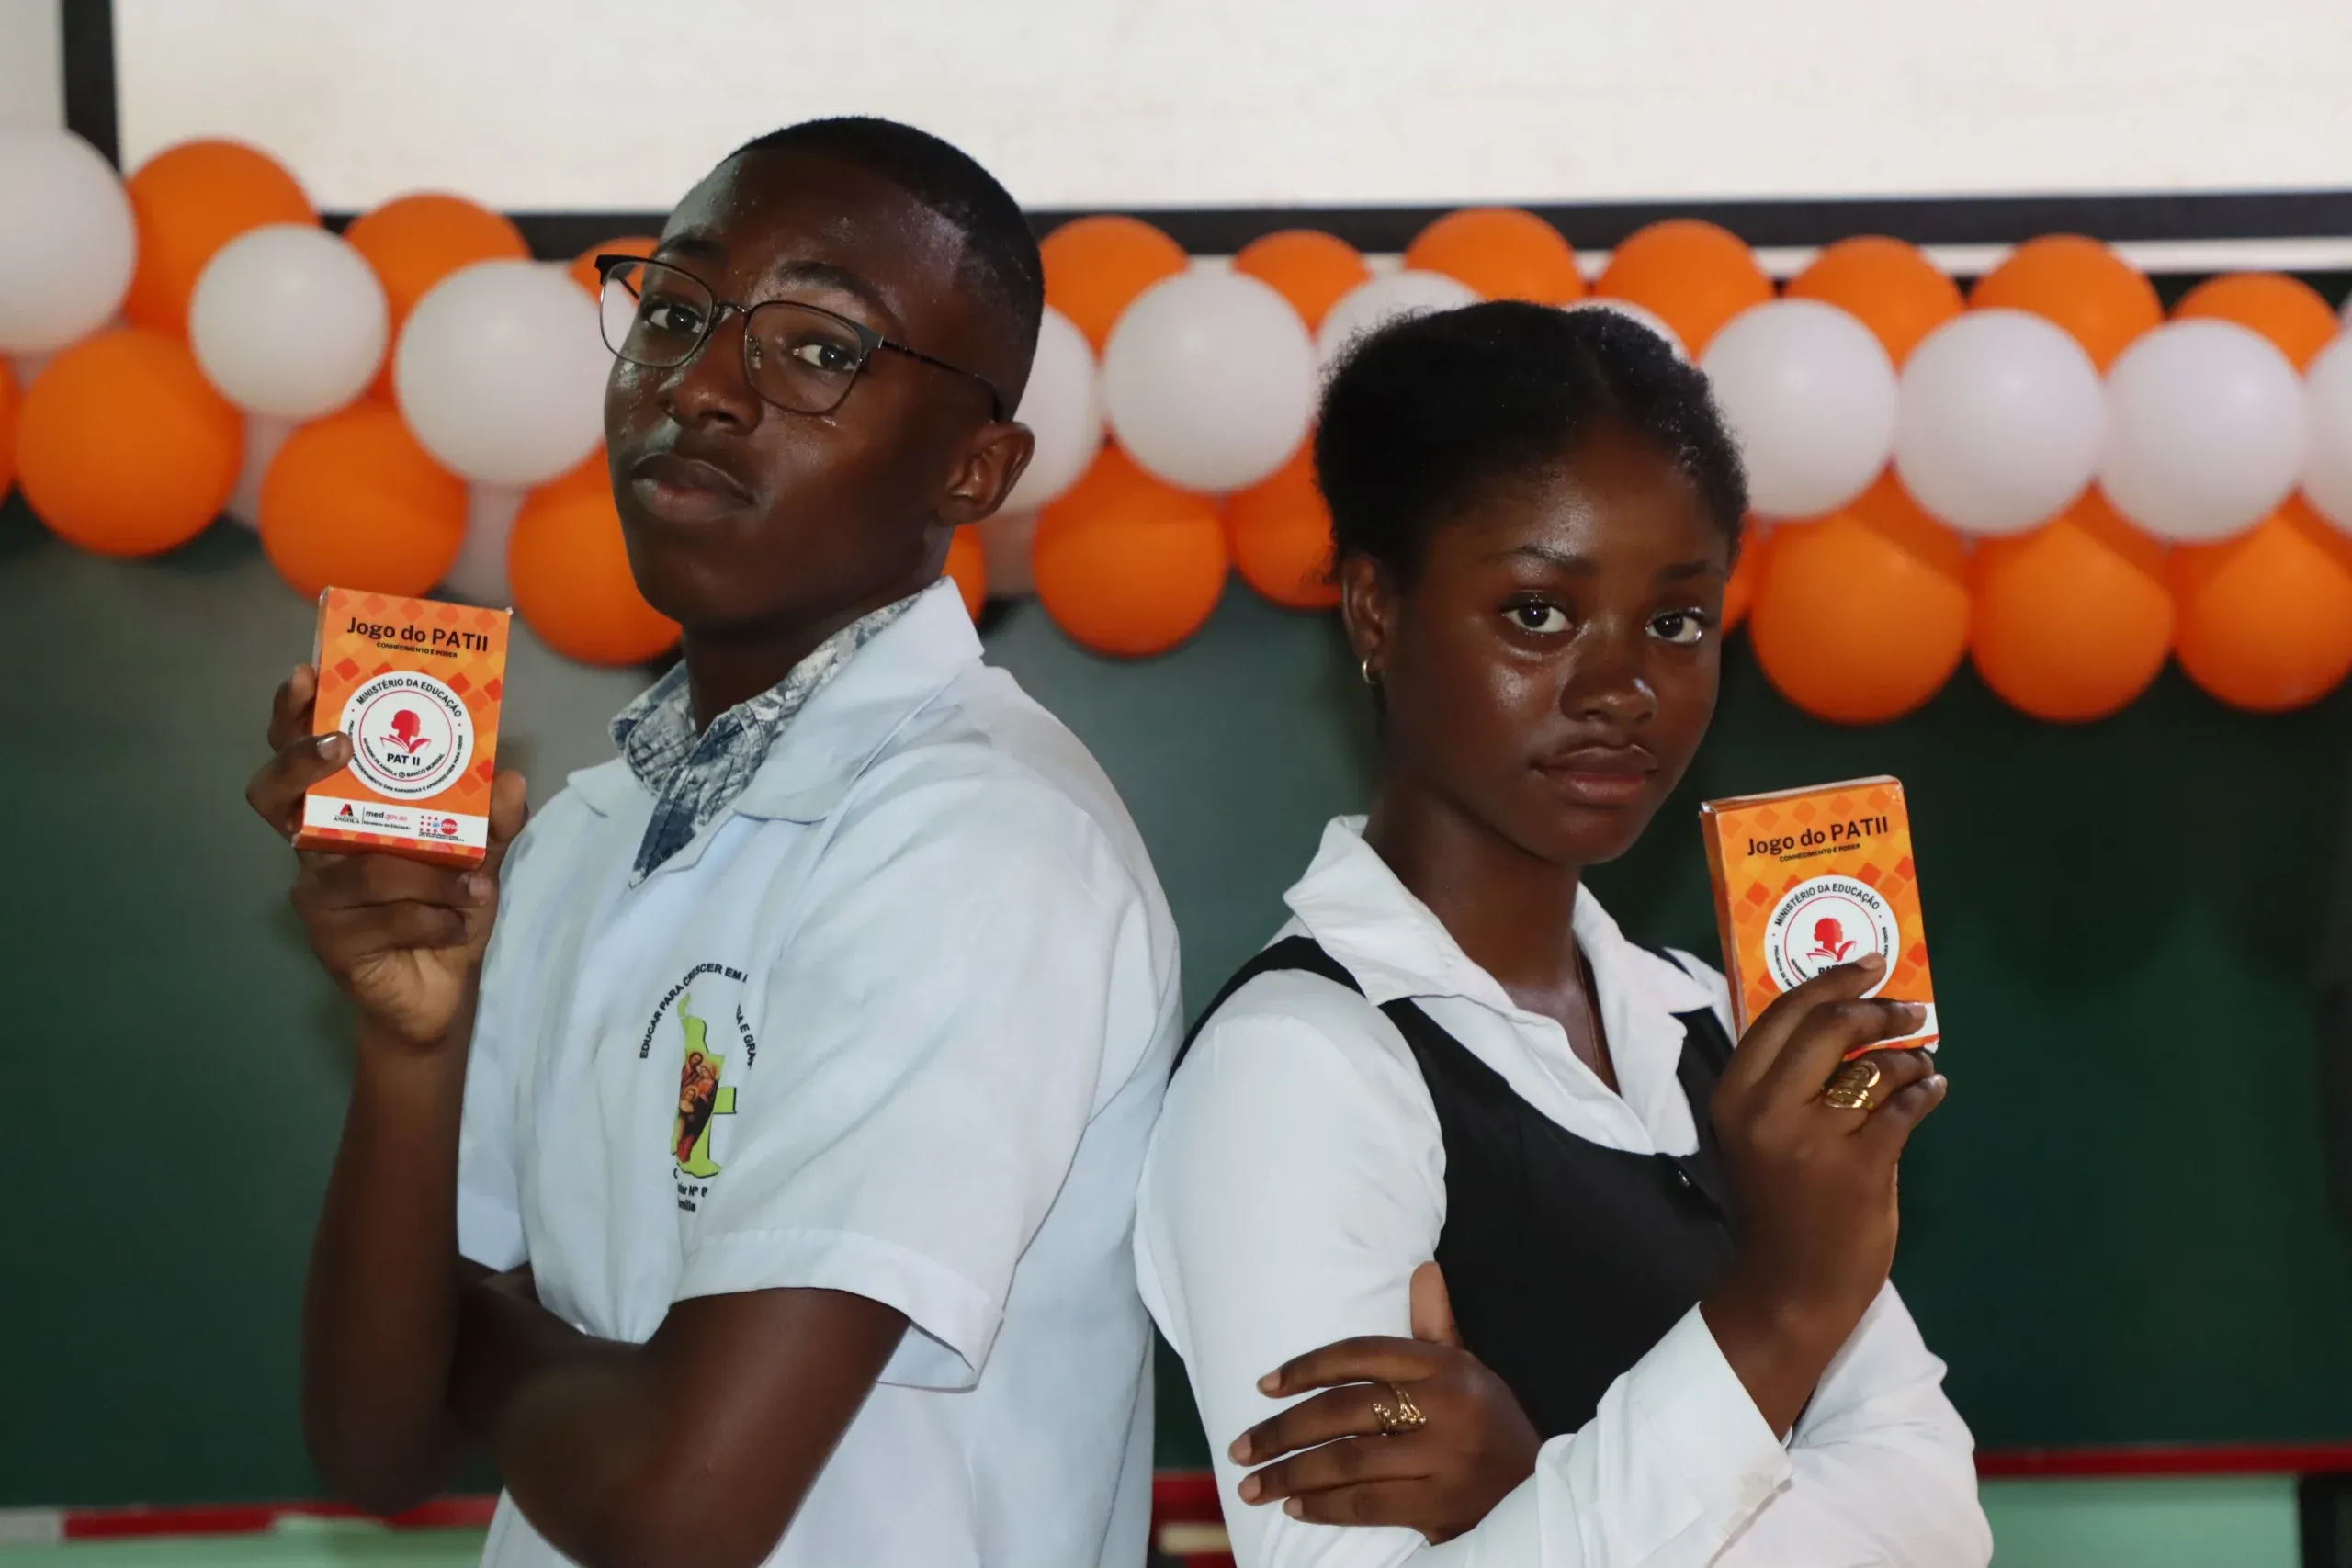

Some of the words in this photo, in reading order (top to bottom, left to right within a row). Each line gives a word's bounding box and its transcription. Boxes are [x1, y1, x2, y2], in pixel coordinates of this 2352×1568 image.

[346, 617, 395, 640] Jogo
[401, 625, 426, 643] do
[432, 628, 488, 652] PATII
[376, 642, 430, 655] CONHECIMENTO
[435, 650, 458, 659] PODER
[356, 678, 404, 705] MINISTÉRIO
[406, 678, 419, 688] DA
[420, 682, 462, 717] EDUCAÇÃO
[387, 753, 409, 765] PAT
[413, 756, 421, 766] II
[334, 816, 360, 825] ANGOLA
[366, 810, 408, 822] med.gov.ao
[1747, 837, 1794, 856] Jogo
[1800, 828, 1826, 846] do
[1830, 816, 1889, 841] PATII
[1779, 848, 1832, 863] CONHECIMENTO
[1838, 843, 1860, 852] PODER
[1774, 887, 1815, 927] MINISTÉRIO
[1817, 884, 1831, 893] DA
[1832, 883, 1880, 910] EDUCAÇÃO
[639, 1010, 663, 1059] EDUCAR
[659, 984, 684, 1011] PARA
[683, 963, 723, 987] CRESCER
[724, 967, 742, 981] EM
[740, 1023, 751, 1033] E
